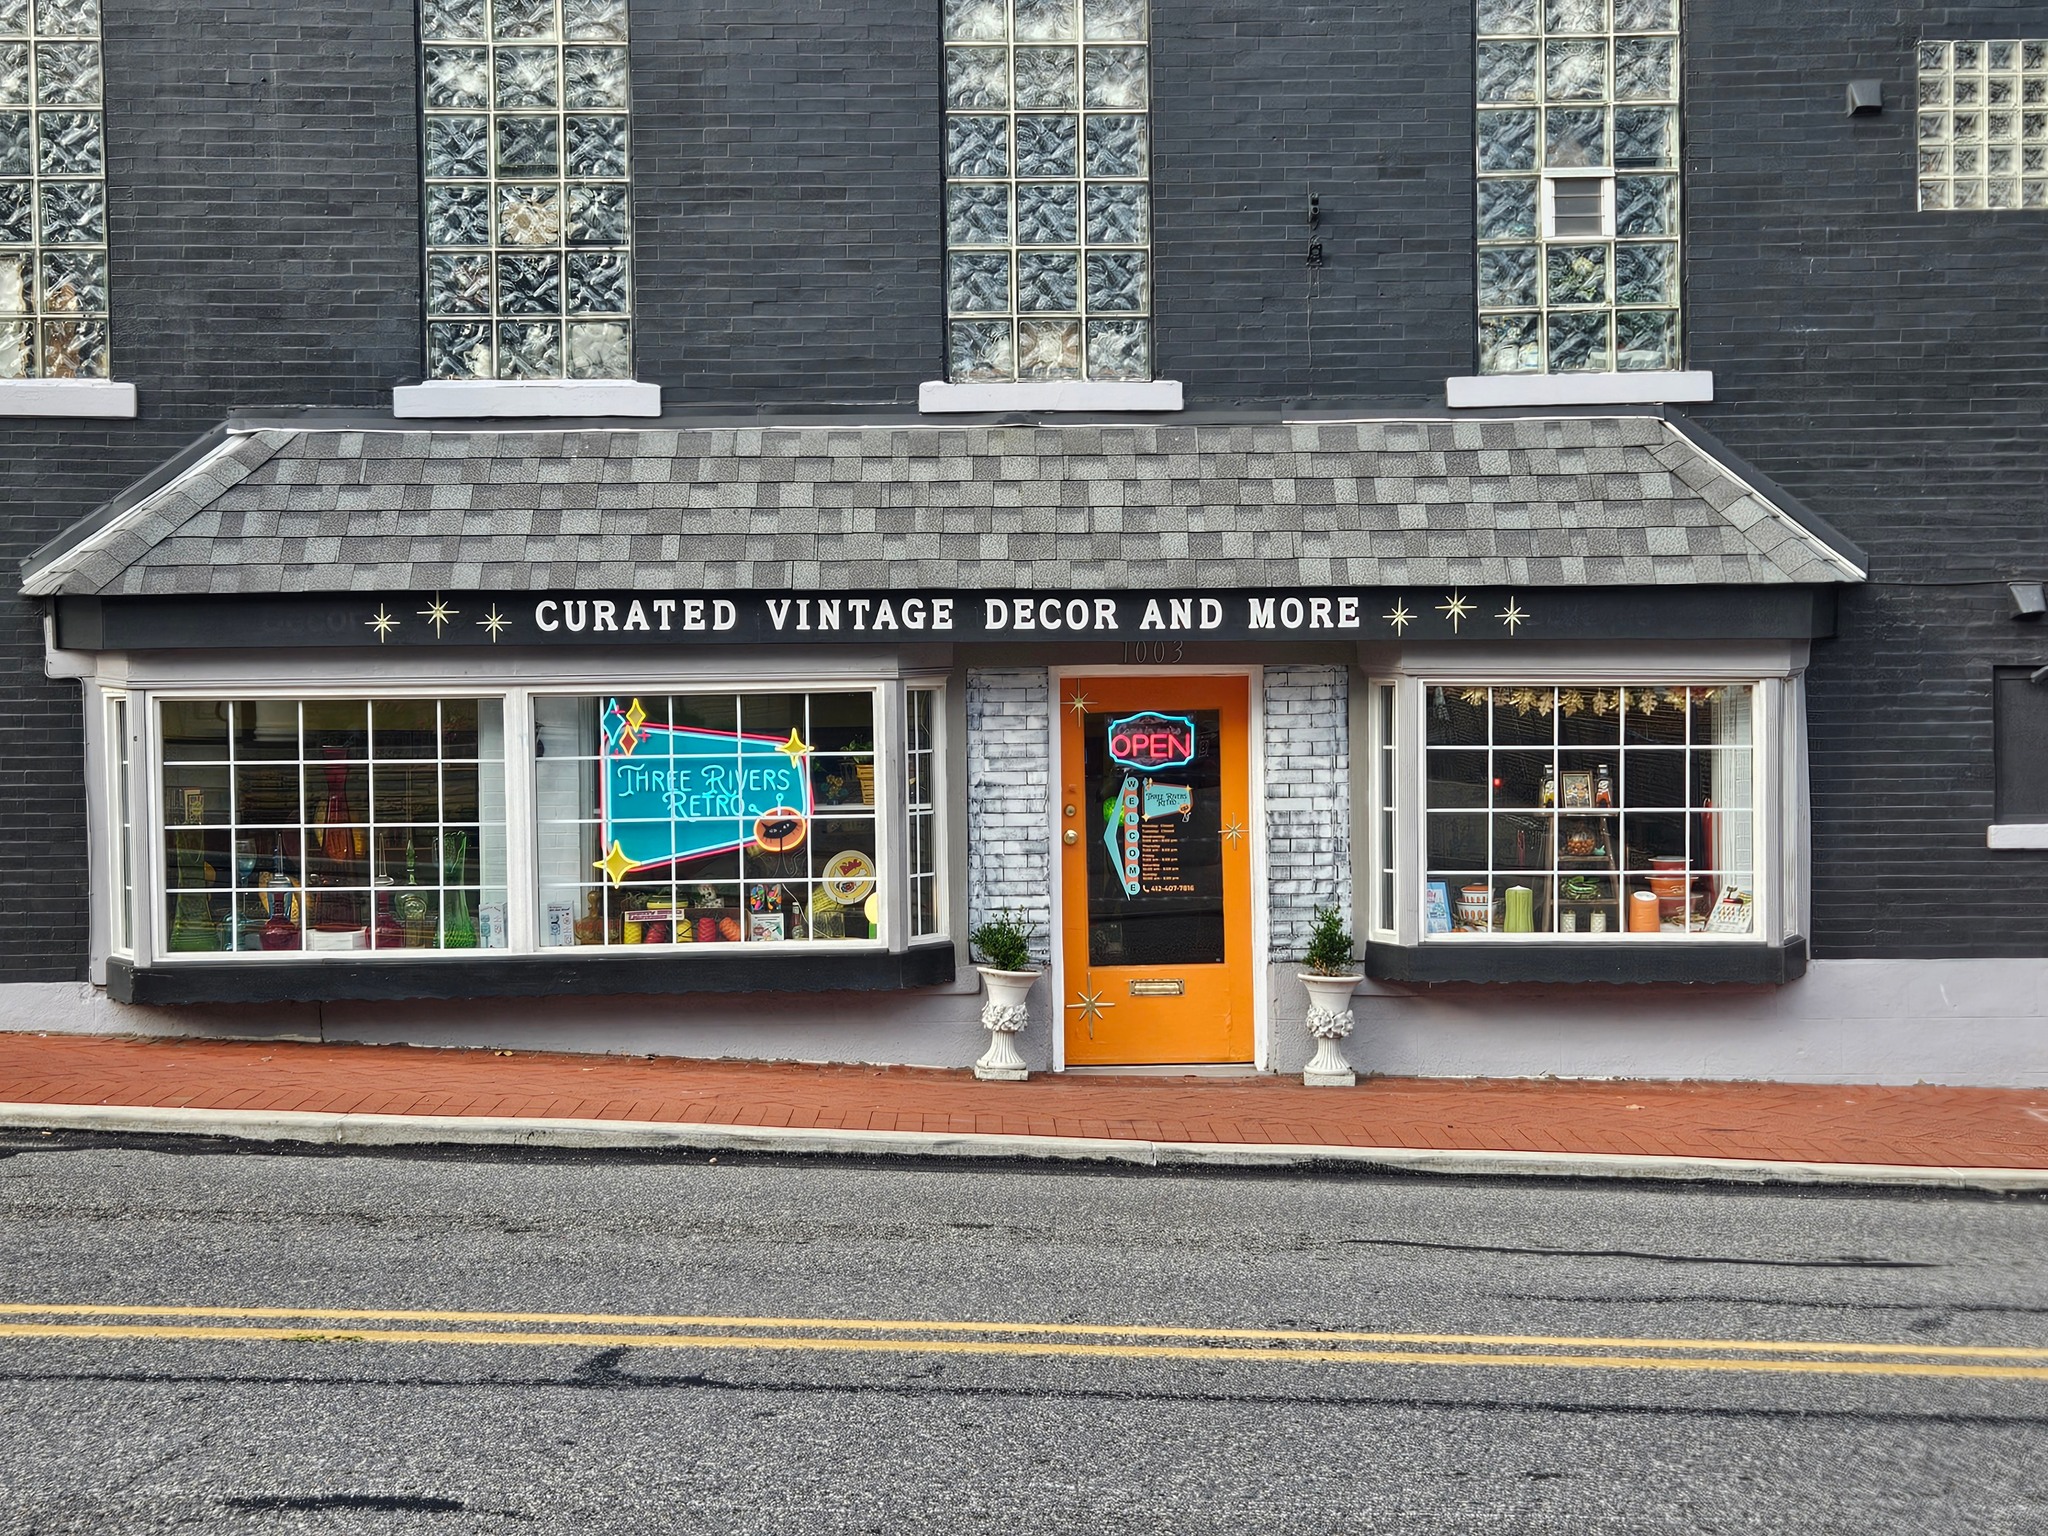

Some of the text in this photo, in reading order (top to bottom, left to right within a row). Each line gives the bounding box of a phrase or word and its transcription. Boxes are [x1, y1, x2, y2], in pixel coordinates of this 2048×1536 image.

[535, 597, 1360, 632] CURATED VINTAGE DECOR AND MORE
[1123, 640, 1183, 663] 1003
[1112, 733, 1191, 758] OPEN
[617, 764, 790, 797] THREE RIVERS
[662, 790, 745, 822] RETRO
[1127, 780, 1138, 890] WELCOME
